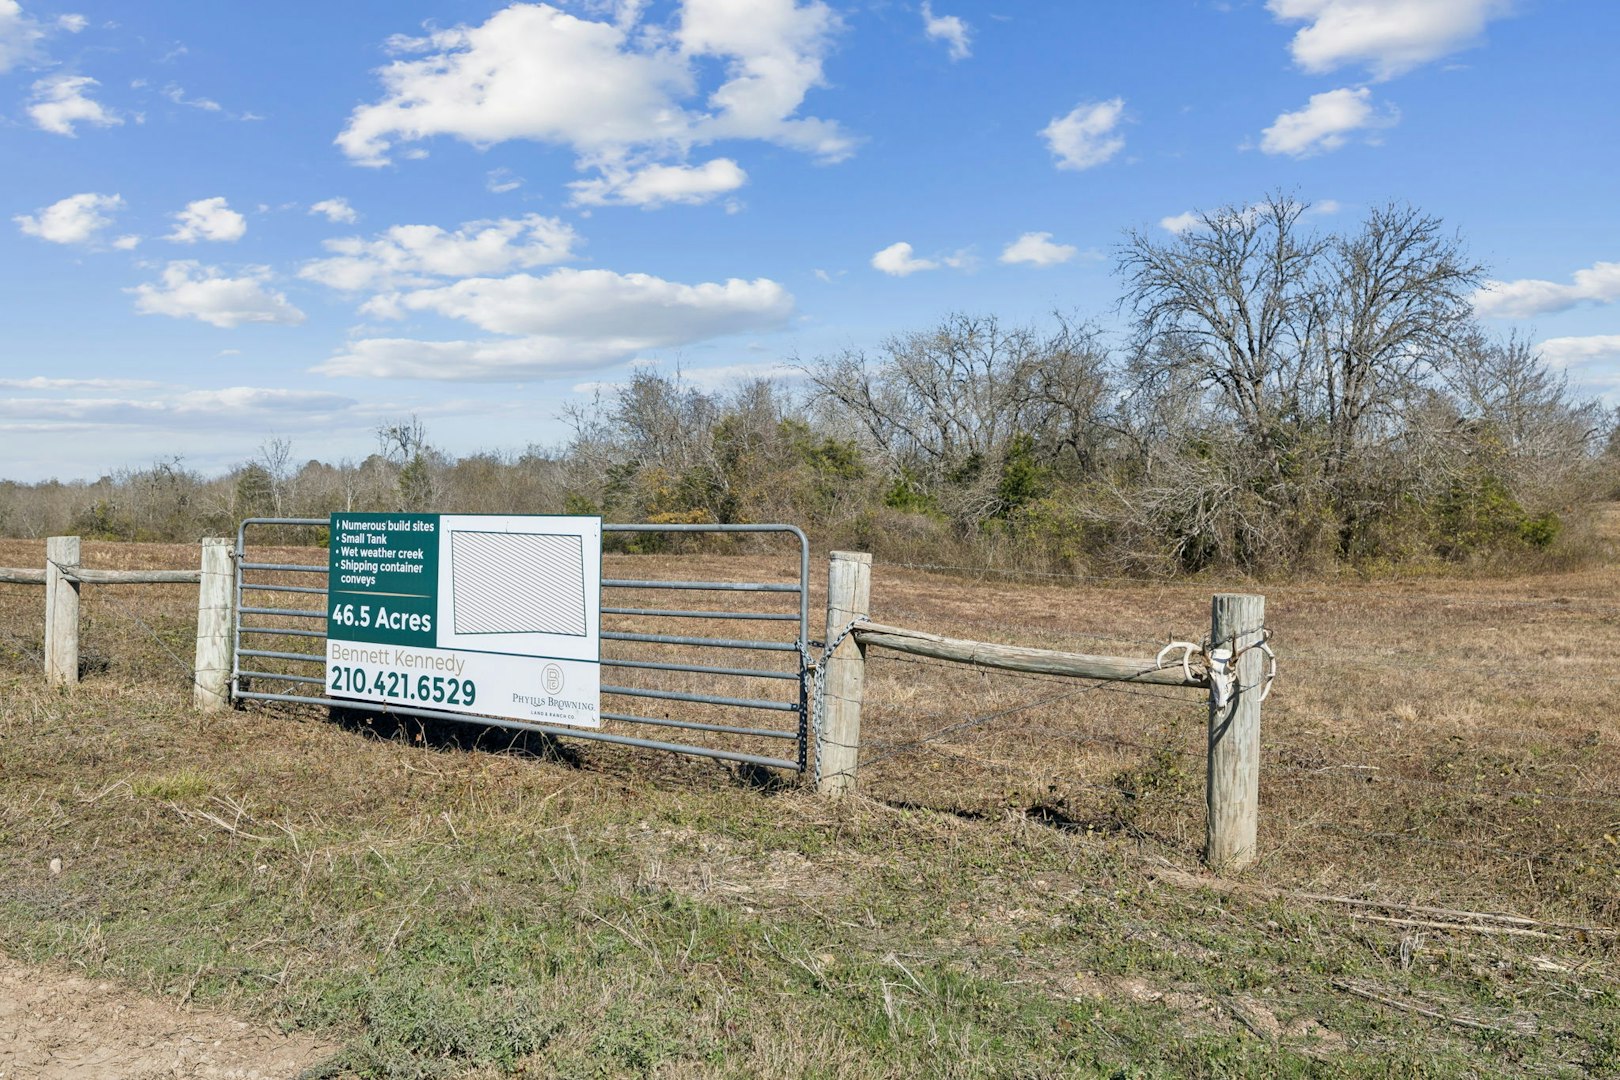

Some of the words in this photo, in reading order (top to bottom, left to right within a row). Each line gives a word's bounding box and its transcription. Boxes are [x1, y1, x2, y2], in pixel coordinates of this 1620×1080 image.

[341, 520, 386, 531] Numerous
[387, 520, 411, 532] build
[412, 521, 435, 532] sites
[341, 532, 365, 544] Small
[367, 533, 387, 545] Tank
[341, 546, 359, 557] Wet
[360, 547, 396, 558] weather
[398, 549, 424, 560] creek
[340, 559, 379, 574] Shipping
[380, 562, 424, 573] container
[341, 575, 376, 587] conveys
[332, 604, 371, 628] 46.5
[375, 606, 432, 632] Acres
[331, 643, 390, 665] Bennett
[395, 649, 465, 676] Kennedy
[331, 666, 476, 706] 210.421.6529
